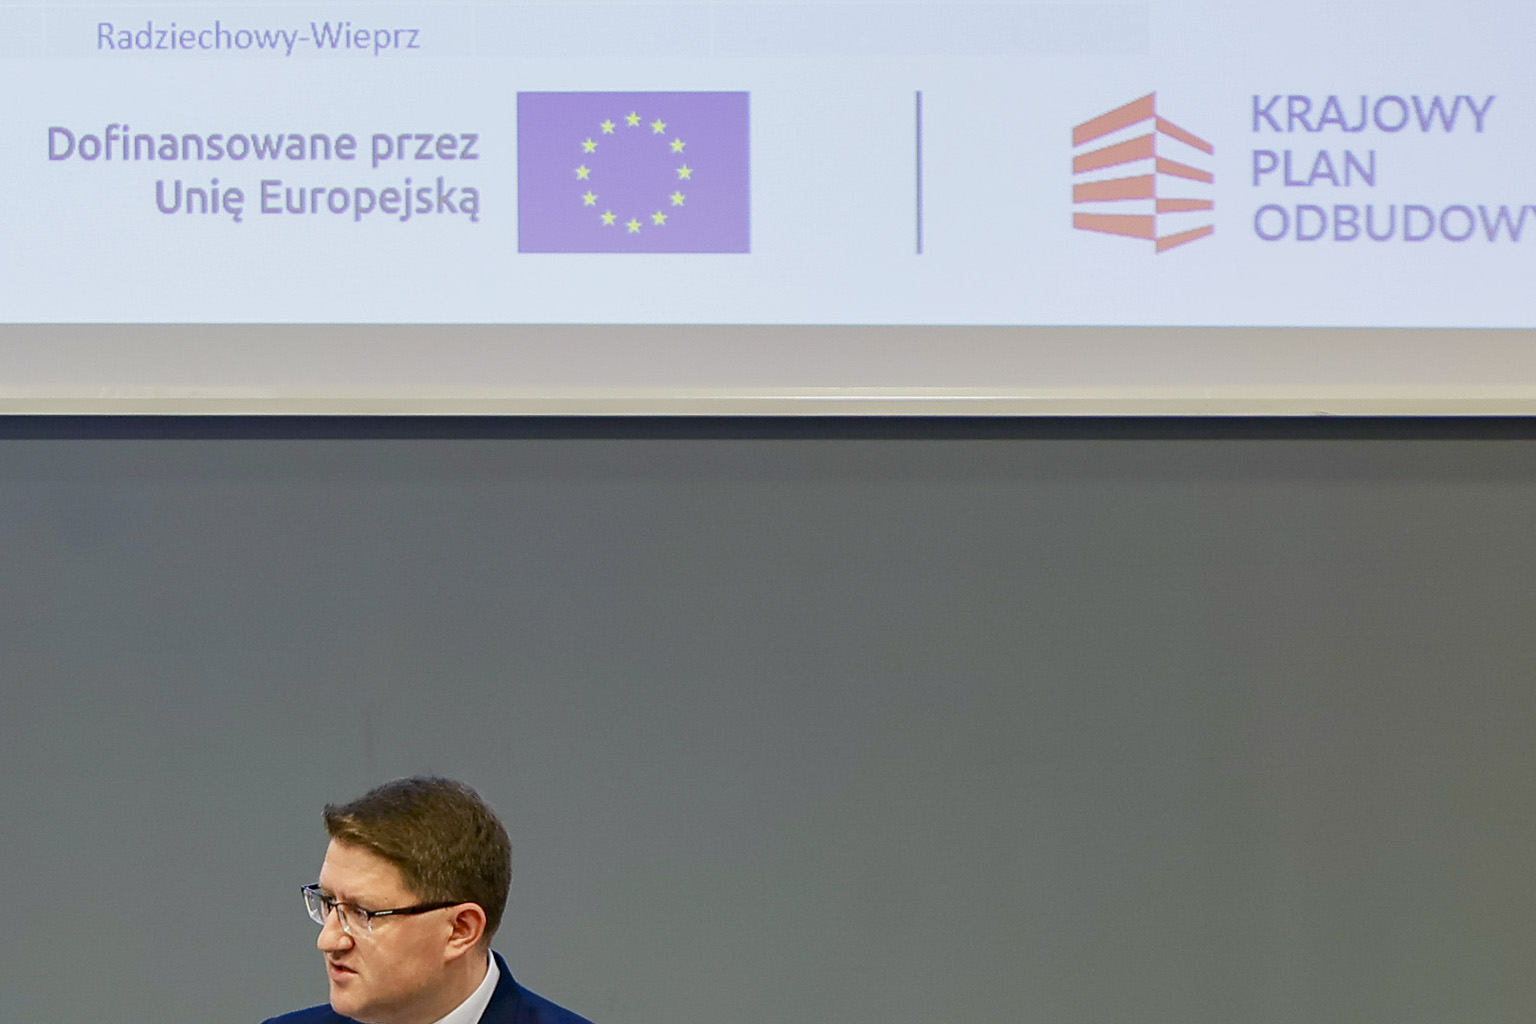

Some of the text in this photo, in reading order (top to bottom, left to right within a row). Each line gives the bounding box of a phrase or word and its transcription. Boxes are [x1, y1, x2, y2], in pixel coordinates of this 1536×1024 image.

[98, 20, 420, 56] Radziechowy-Wieprz
[1252, 95, 1495, 133] KRAJOWY
[49, 124, 479, 169] Dofinansowane przez
[1253, 150, 1375, 187] PLAN
[156, 176, 479, 223] Unię Europejską
